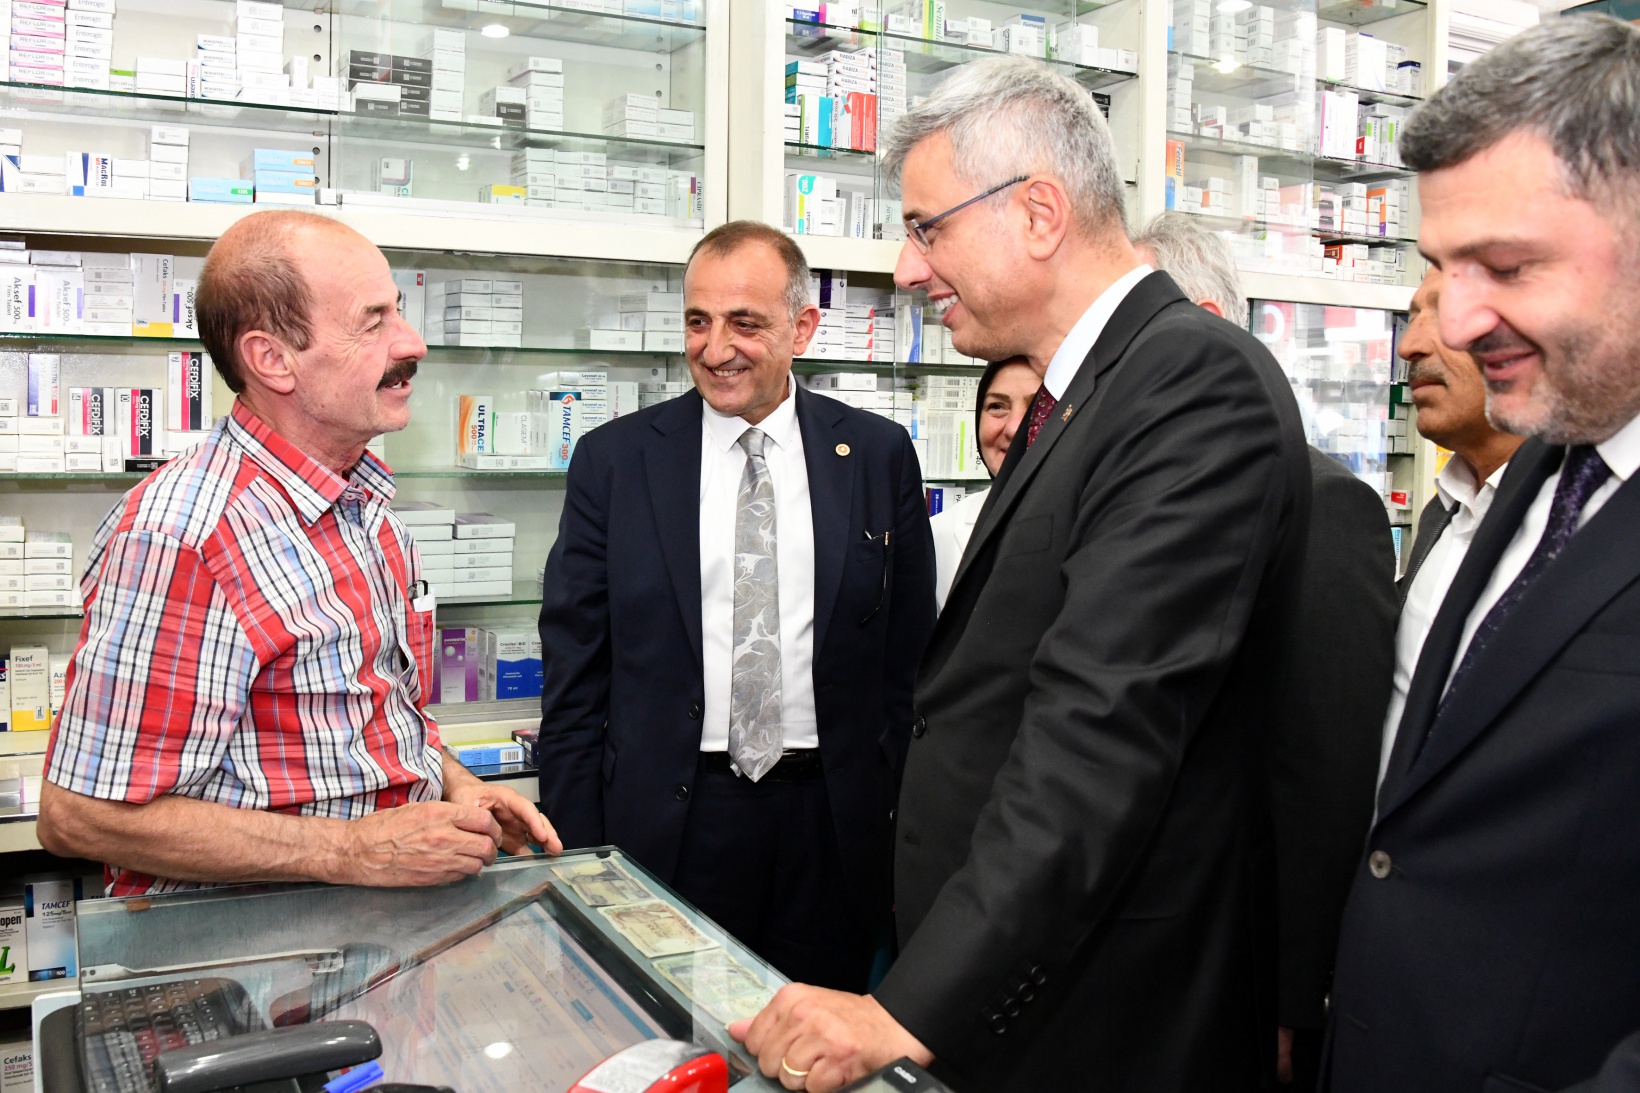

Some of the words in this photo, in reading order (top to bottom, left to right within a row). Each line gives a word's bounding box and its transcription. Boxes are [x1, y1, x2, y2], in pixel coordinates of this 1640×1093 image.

[936, 4, 944, 41] Sennala
[14, 277, 22, 303] Aksef
[63, 280, 71, 306] Aksef
[562, 406, 571, 443] TAMCEF
[42, 901, 71, 910] TAMCEF
[4, 1054, 32, 1064] Cefaks
